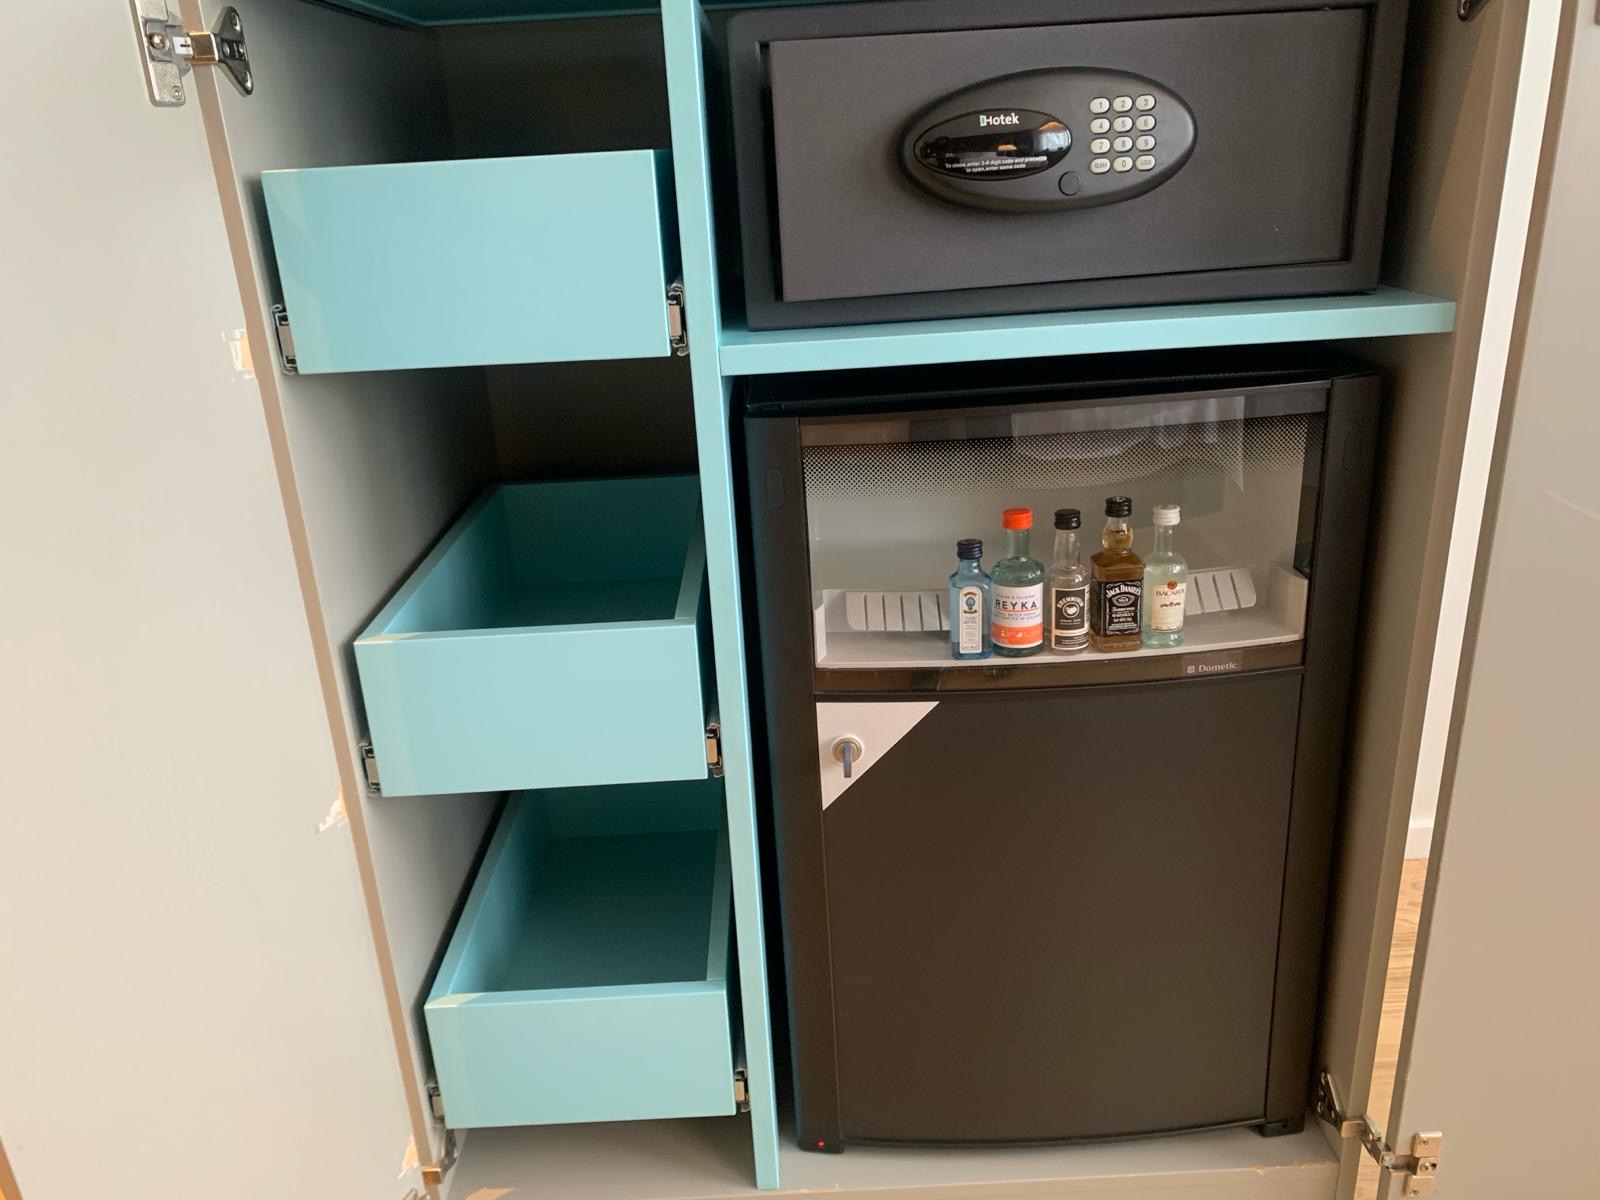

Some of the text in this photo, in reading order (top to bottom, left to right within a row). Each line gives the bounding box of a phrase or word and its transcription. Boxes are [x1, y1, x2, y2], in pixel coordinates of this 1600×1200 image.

[980, 113, 1019, 126] Hotek
[1106, 586, 1120, 598] JACK
[994, 599, 1037, 611] REYKA
[1198, 661, 1238, 673] Dometic
